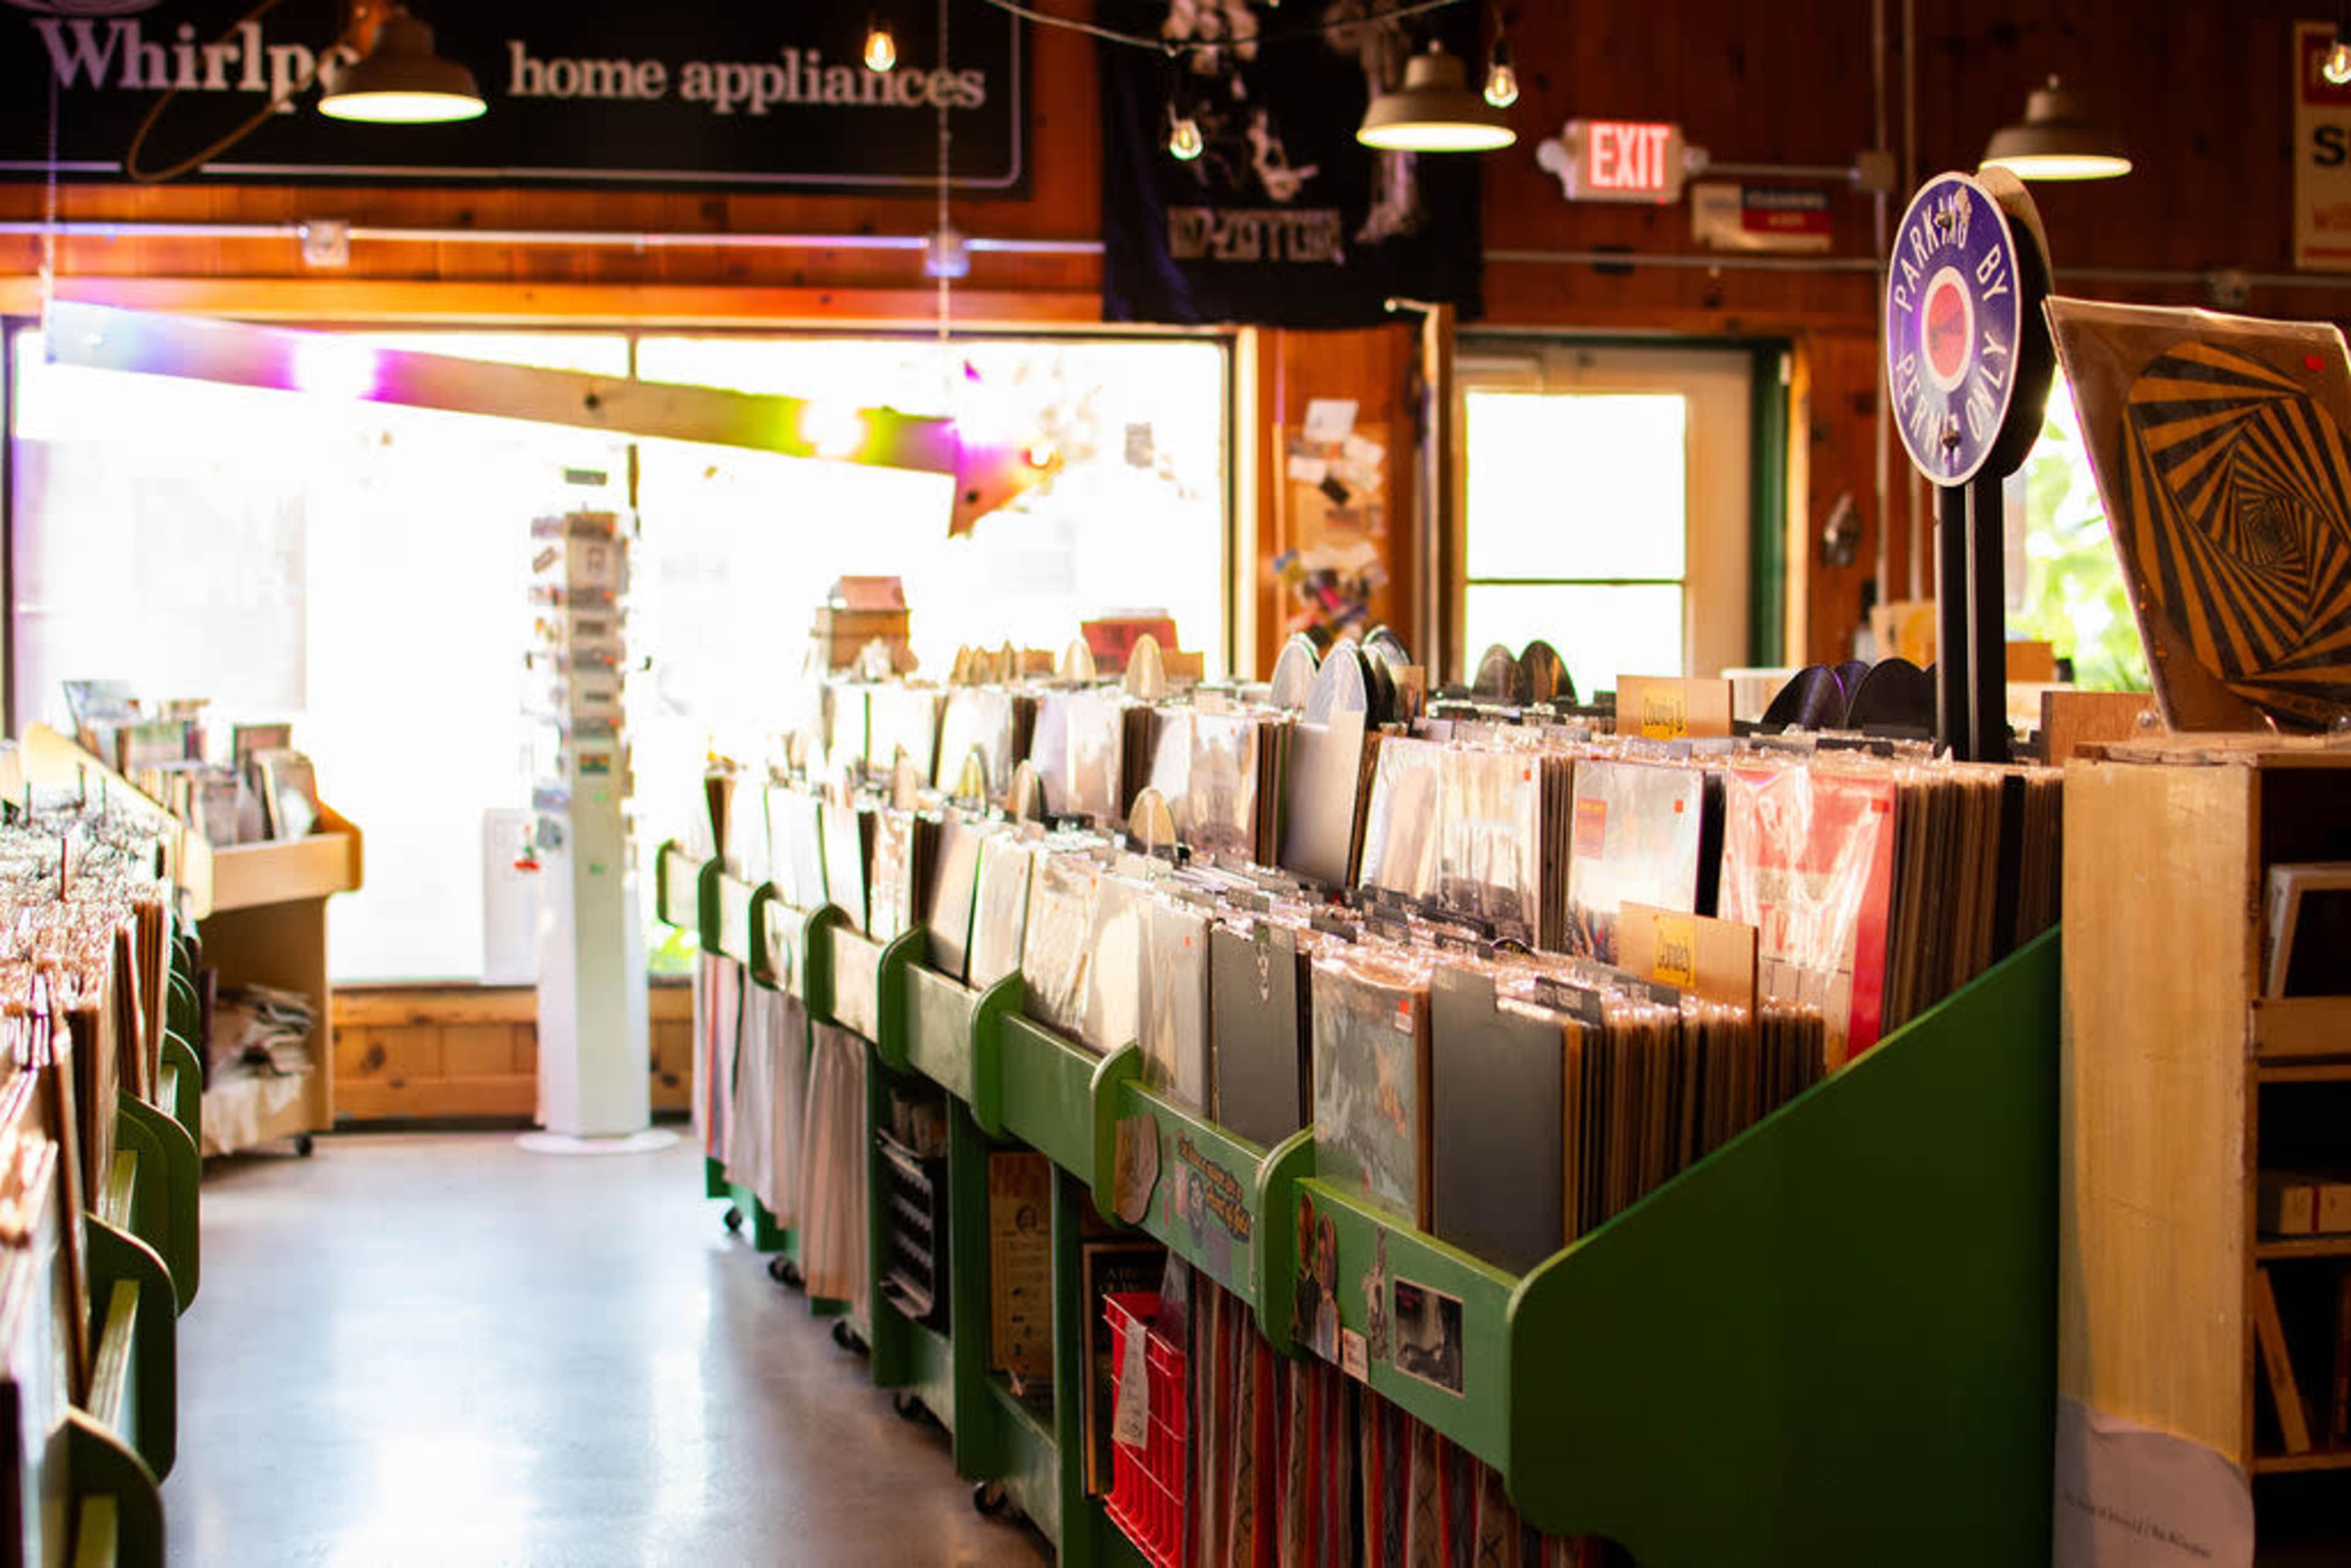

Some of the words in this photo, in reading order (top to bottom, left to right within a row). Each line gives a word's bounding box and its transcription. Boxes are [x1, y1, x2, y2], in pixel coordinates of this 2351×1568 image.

[508, 40, 668, 100] home
[680, 47, 986, 116] appliances
[1592, 124, 1670, 189] EXIT
[1975, 243, 2009, 302] BY
[1965, 329, 2009, 442] ONLY
